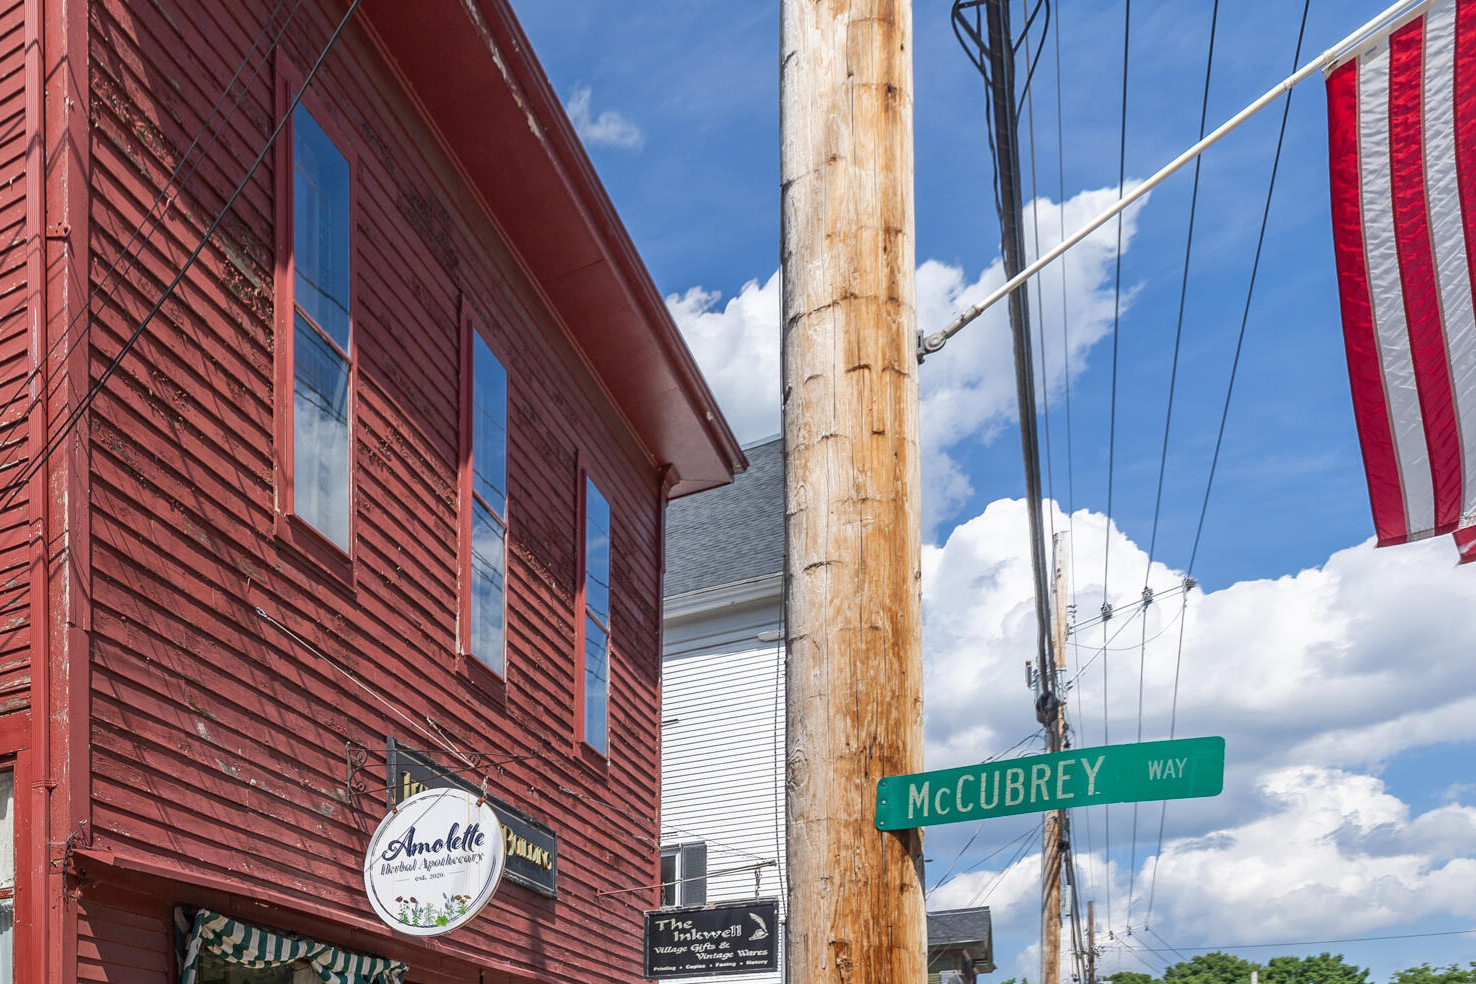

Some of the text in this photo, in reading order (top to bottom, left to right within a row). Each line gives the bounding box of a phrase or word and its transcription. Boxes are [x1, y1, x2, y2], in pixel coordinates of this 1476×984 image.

[907, 755, 1188, 819] McCUBREY WAY
[381, 822, 485, 861] Amolette
[380, 853, 485, 876] Herbal Apothecary
[654, 918, 693, 932] The
[673, 924, 742, 942] Inkwell
[654, 941, 731, 955] Village Gifts &
[695, 949, 769, 961] Vintage Wares
